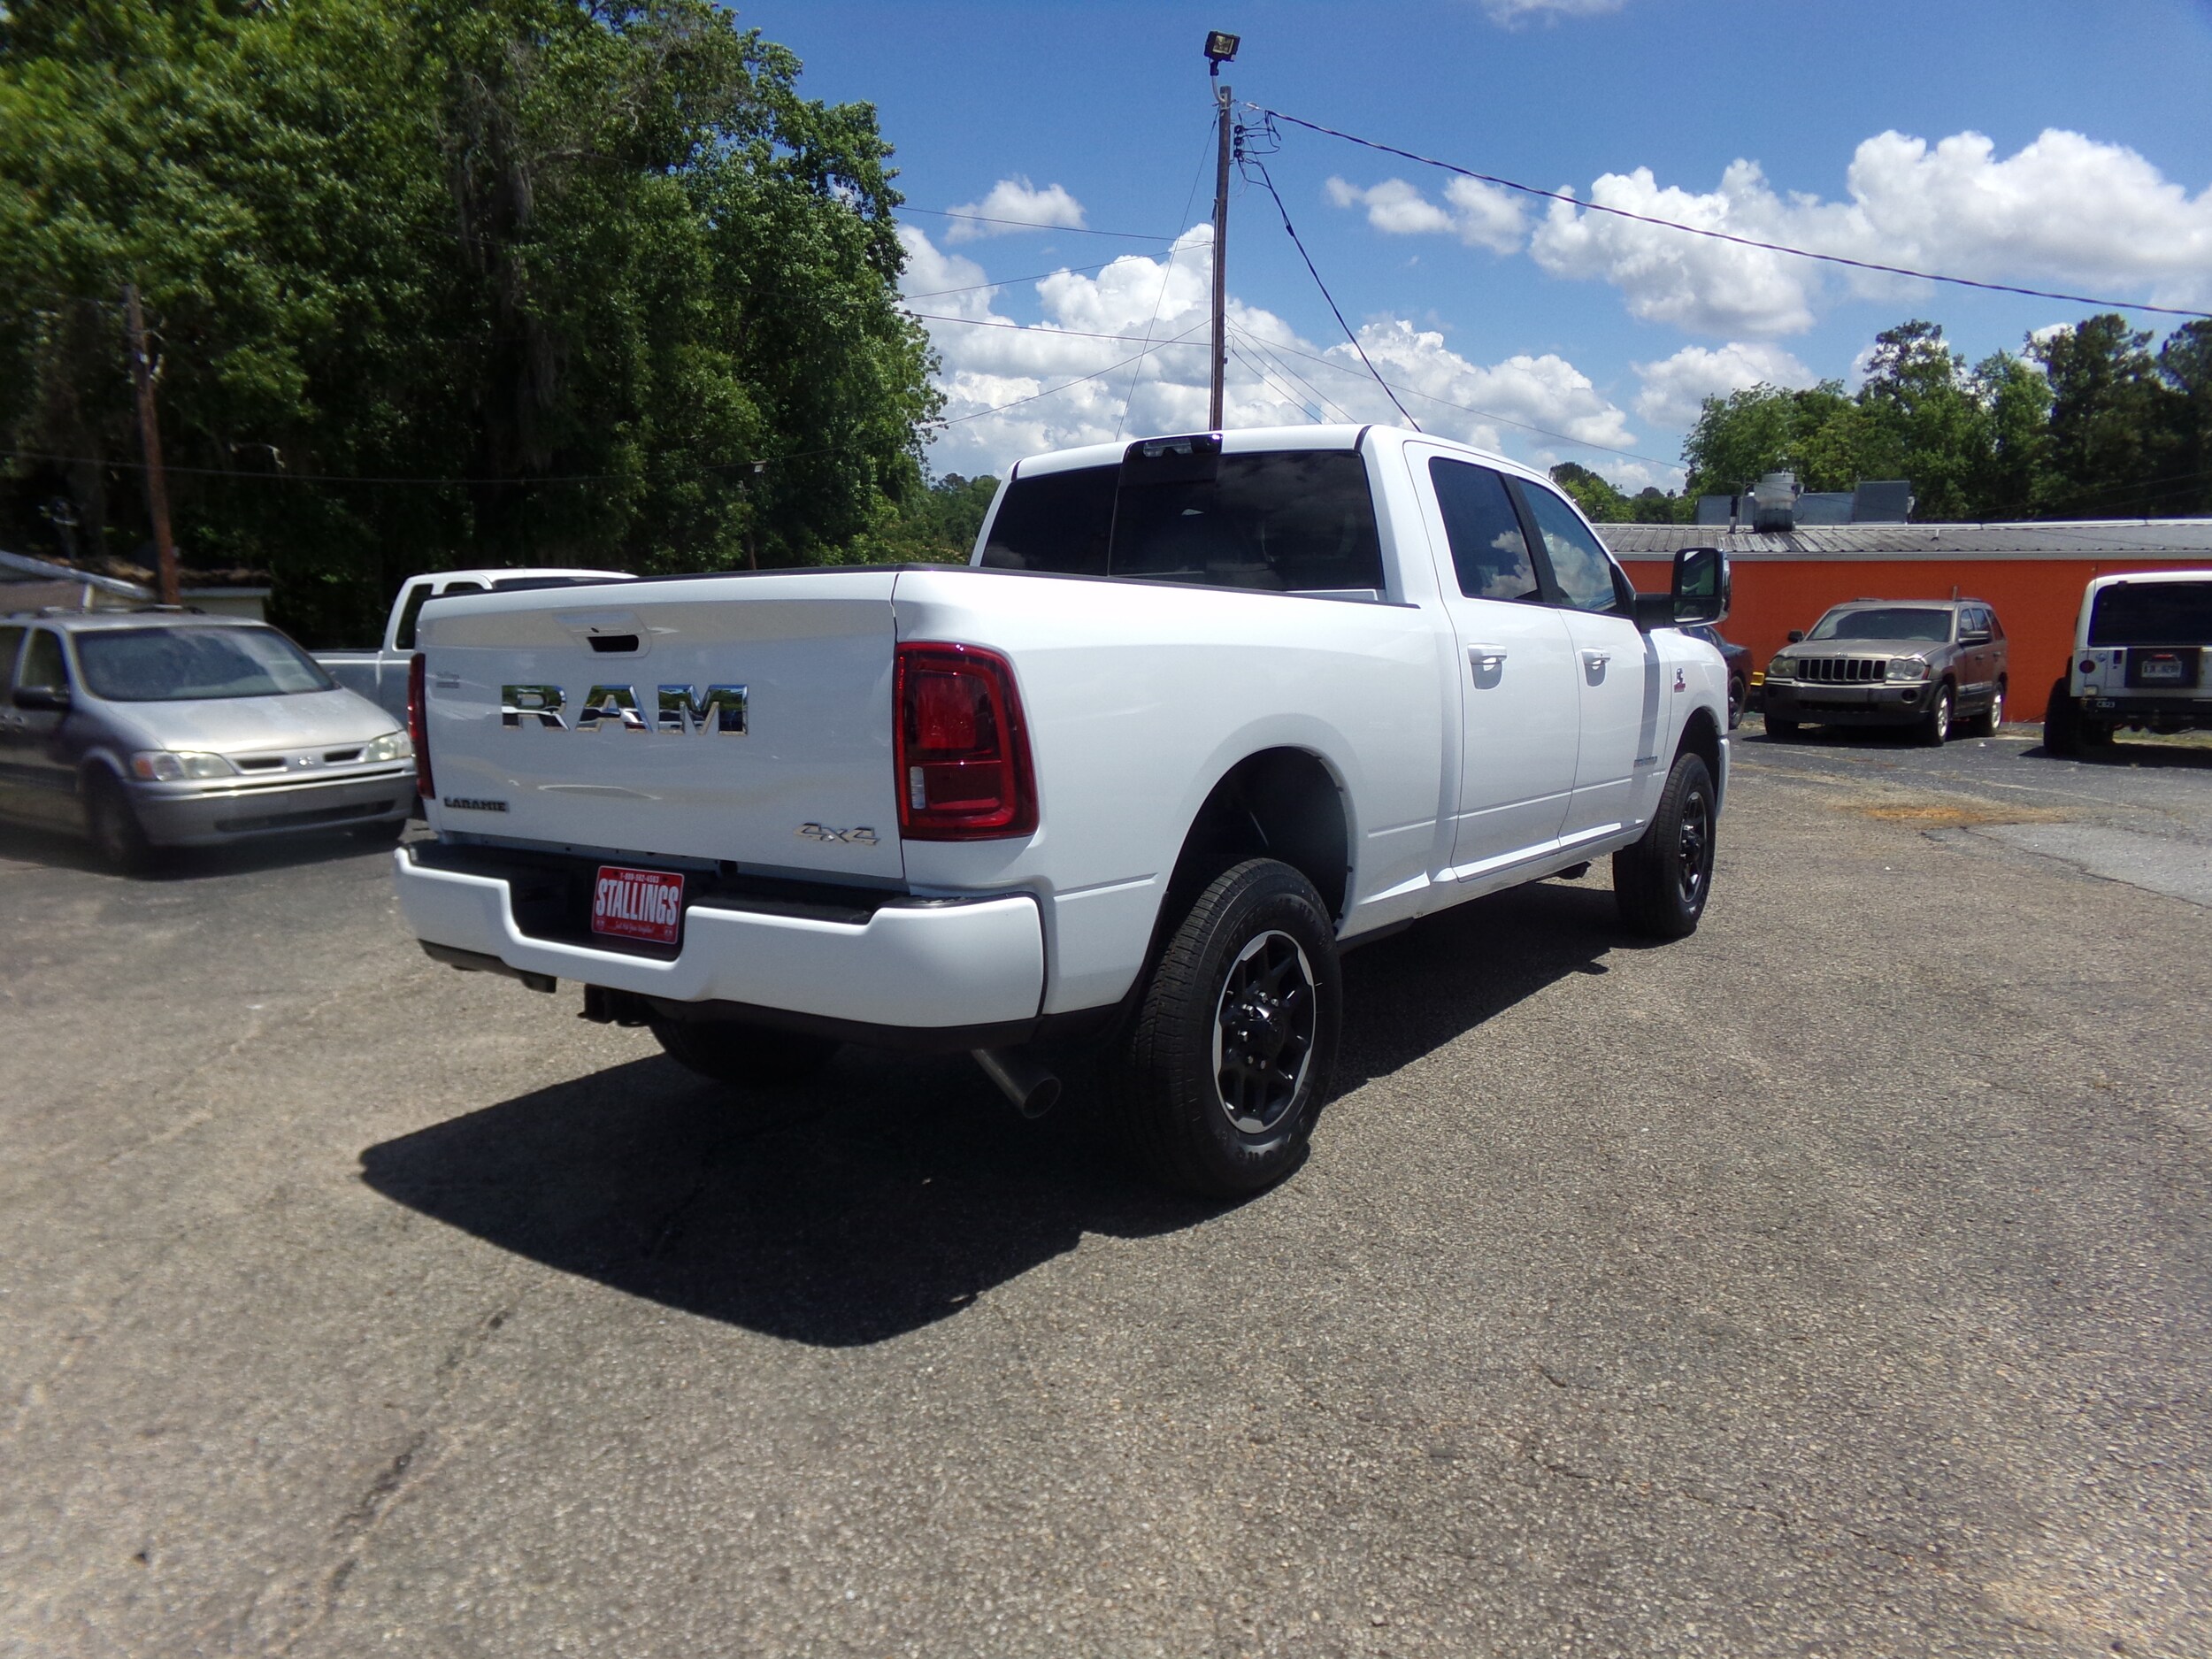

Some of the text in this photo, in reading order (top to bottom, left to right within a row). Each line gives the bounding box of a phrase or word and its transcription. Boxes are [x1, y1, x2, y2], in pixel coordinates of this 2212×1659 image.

[501, 684, 749, 736] RAM
[444, 796, 508, 812] LARAMIE
[595, 878, 680, 926] STALLINGS
